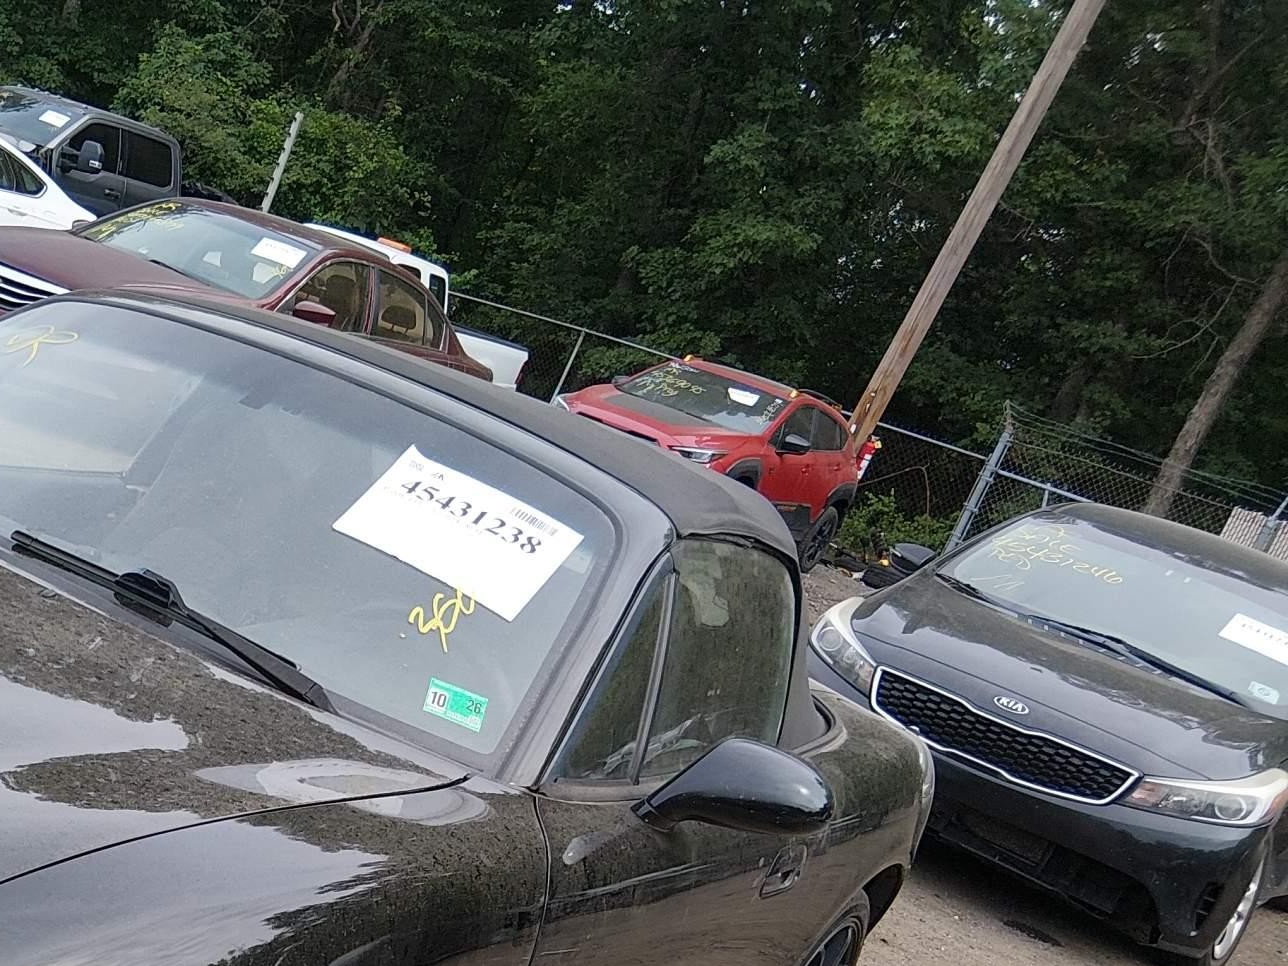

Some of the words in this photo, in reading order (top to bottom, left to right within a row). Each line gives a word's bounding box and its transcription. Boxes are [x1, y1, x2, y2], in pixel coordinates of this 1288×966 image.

[401, 480, 542, 554] 45431238
[431, 691, 447, 708] 10
[466, 699, 482, 715] 26
[997, 696, 1025, 712] KIA
